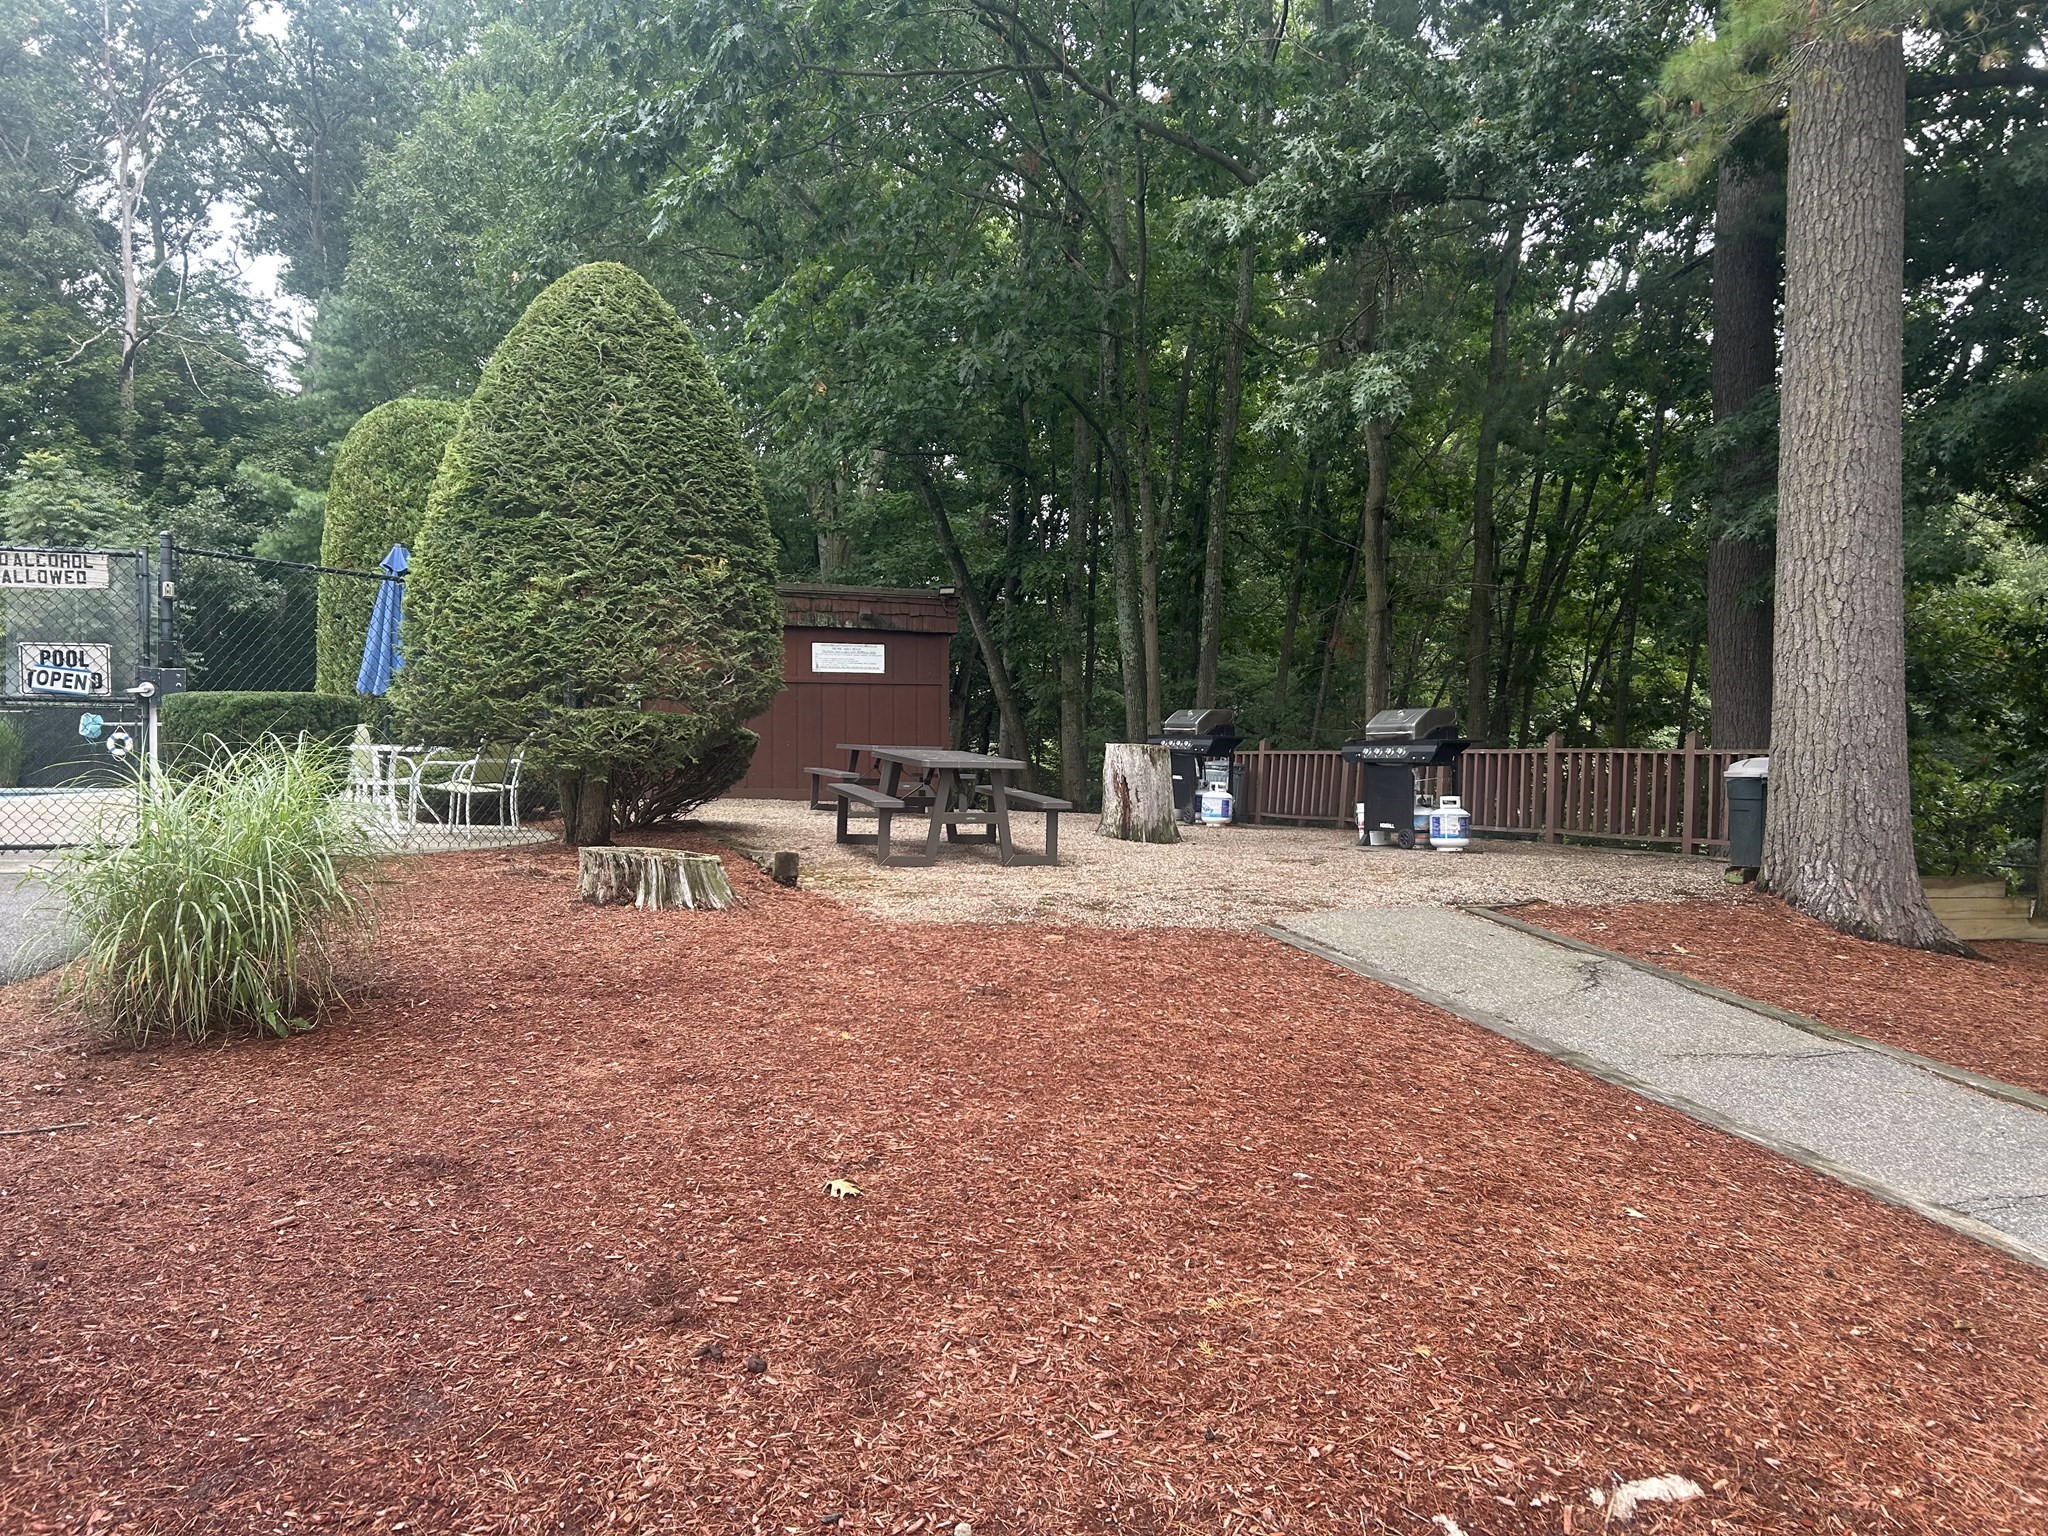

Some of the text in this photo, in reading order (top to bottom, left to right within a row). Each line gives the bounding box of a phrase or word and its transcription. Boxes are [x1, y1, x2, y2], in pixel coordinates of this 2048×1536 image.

[0, 552, 93, 568] O ALCOHOL
[2, 566, 87, 584] ALLOWED
[39, 649, 89, 667] POOL
[36, 669, 88, 691] OPEN
